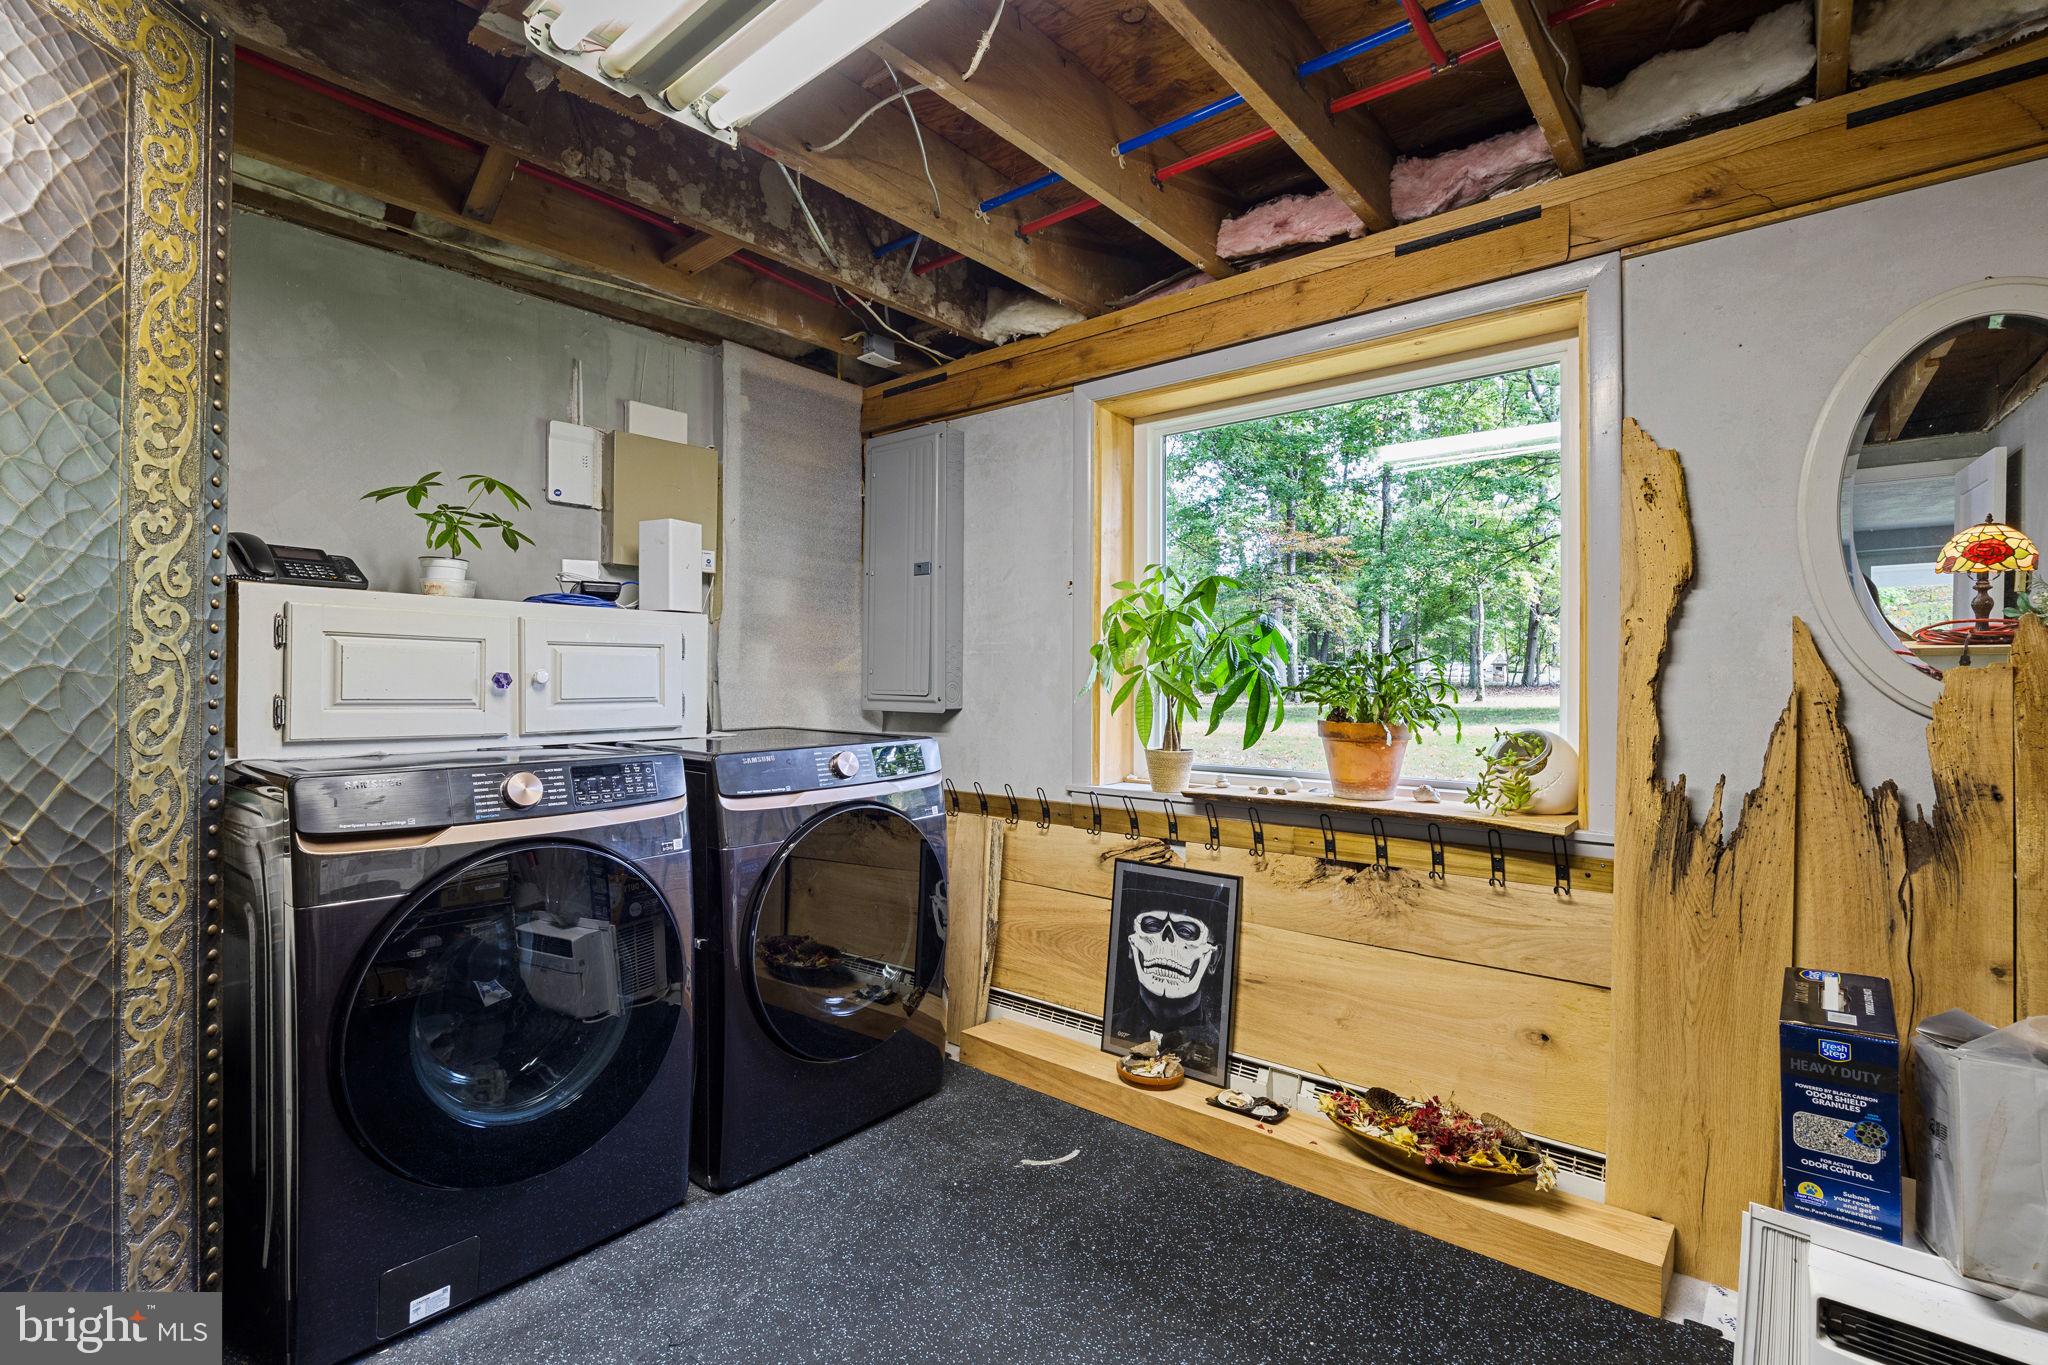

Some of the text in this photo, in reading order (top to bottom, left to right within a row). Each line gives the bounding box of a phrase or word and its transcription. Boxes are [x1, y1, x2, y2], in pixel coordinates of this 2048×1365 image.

[742, 755, 775, 764] SAMSUNG
[1821, 1041, 1848, 1053] Fresh
[1823, 1049, 1847, 1060] Step
[1790, 1057, 1881, 1085] HEAVY DUTY
[1795, 1082, 1824, 1092] POWERED
[1832, 1089, 1852, 1098] BLACK
[1852, 1094, 1879, 1103] CARBON
[1805, 1089, 1867, 1108] ODOR SHIELD
[1811, 1097, 1861, 1113] GRANULES
[1801, 1158, 1875, 1181] ODOR CONTROL
[1833, 1160, 1854, 1169] ACTIVE
[1833, 1195, 1851, 1204] your
[1852, 1199, 1880, 1211] receipt
[1843, 1191, 1870, 1202] Submit
[1843, 1203, 1873, 1215] and get
